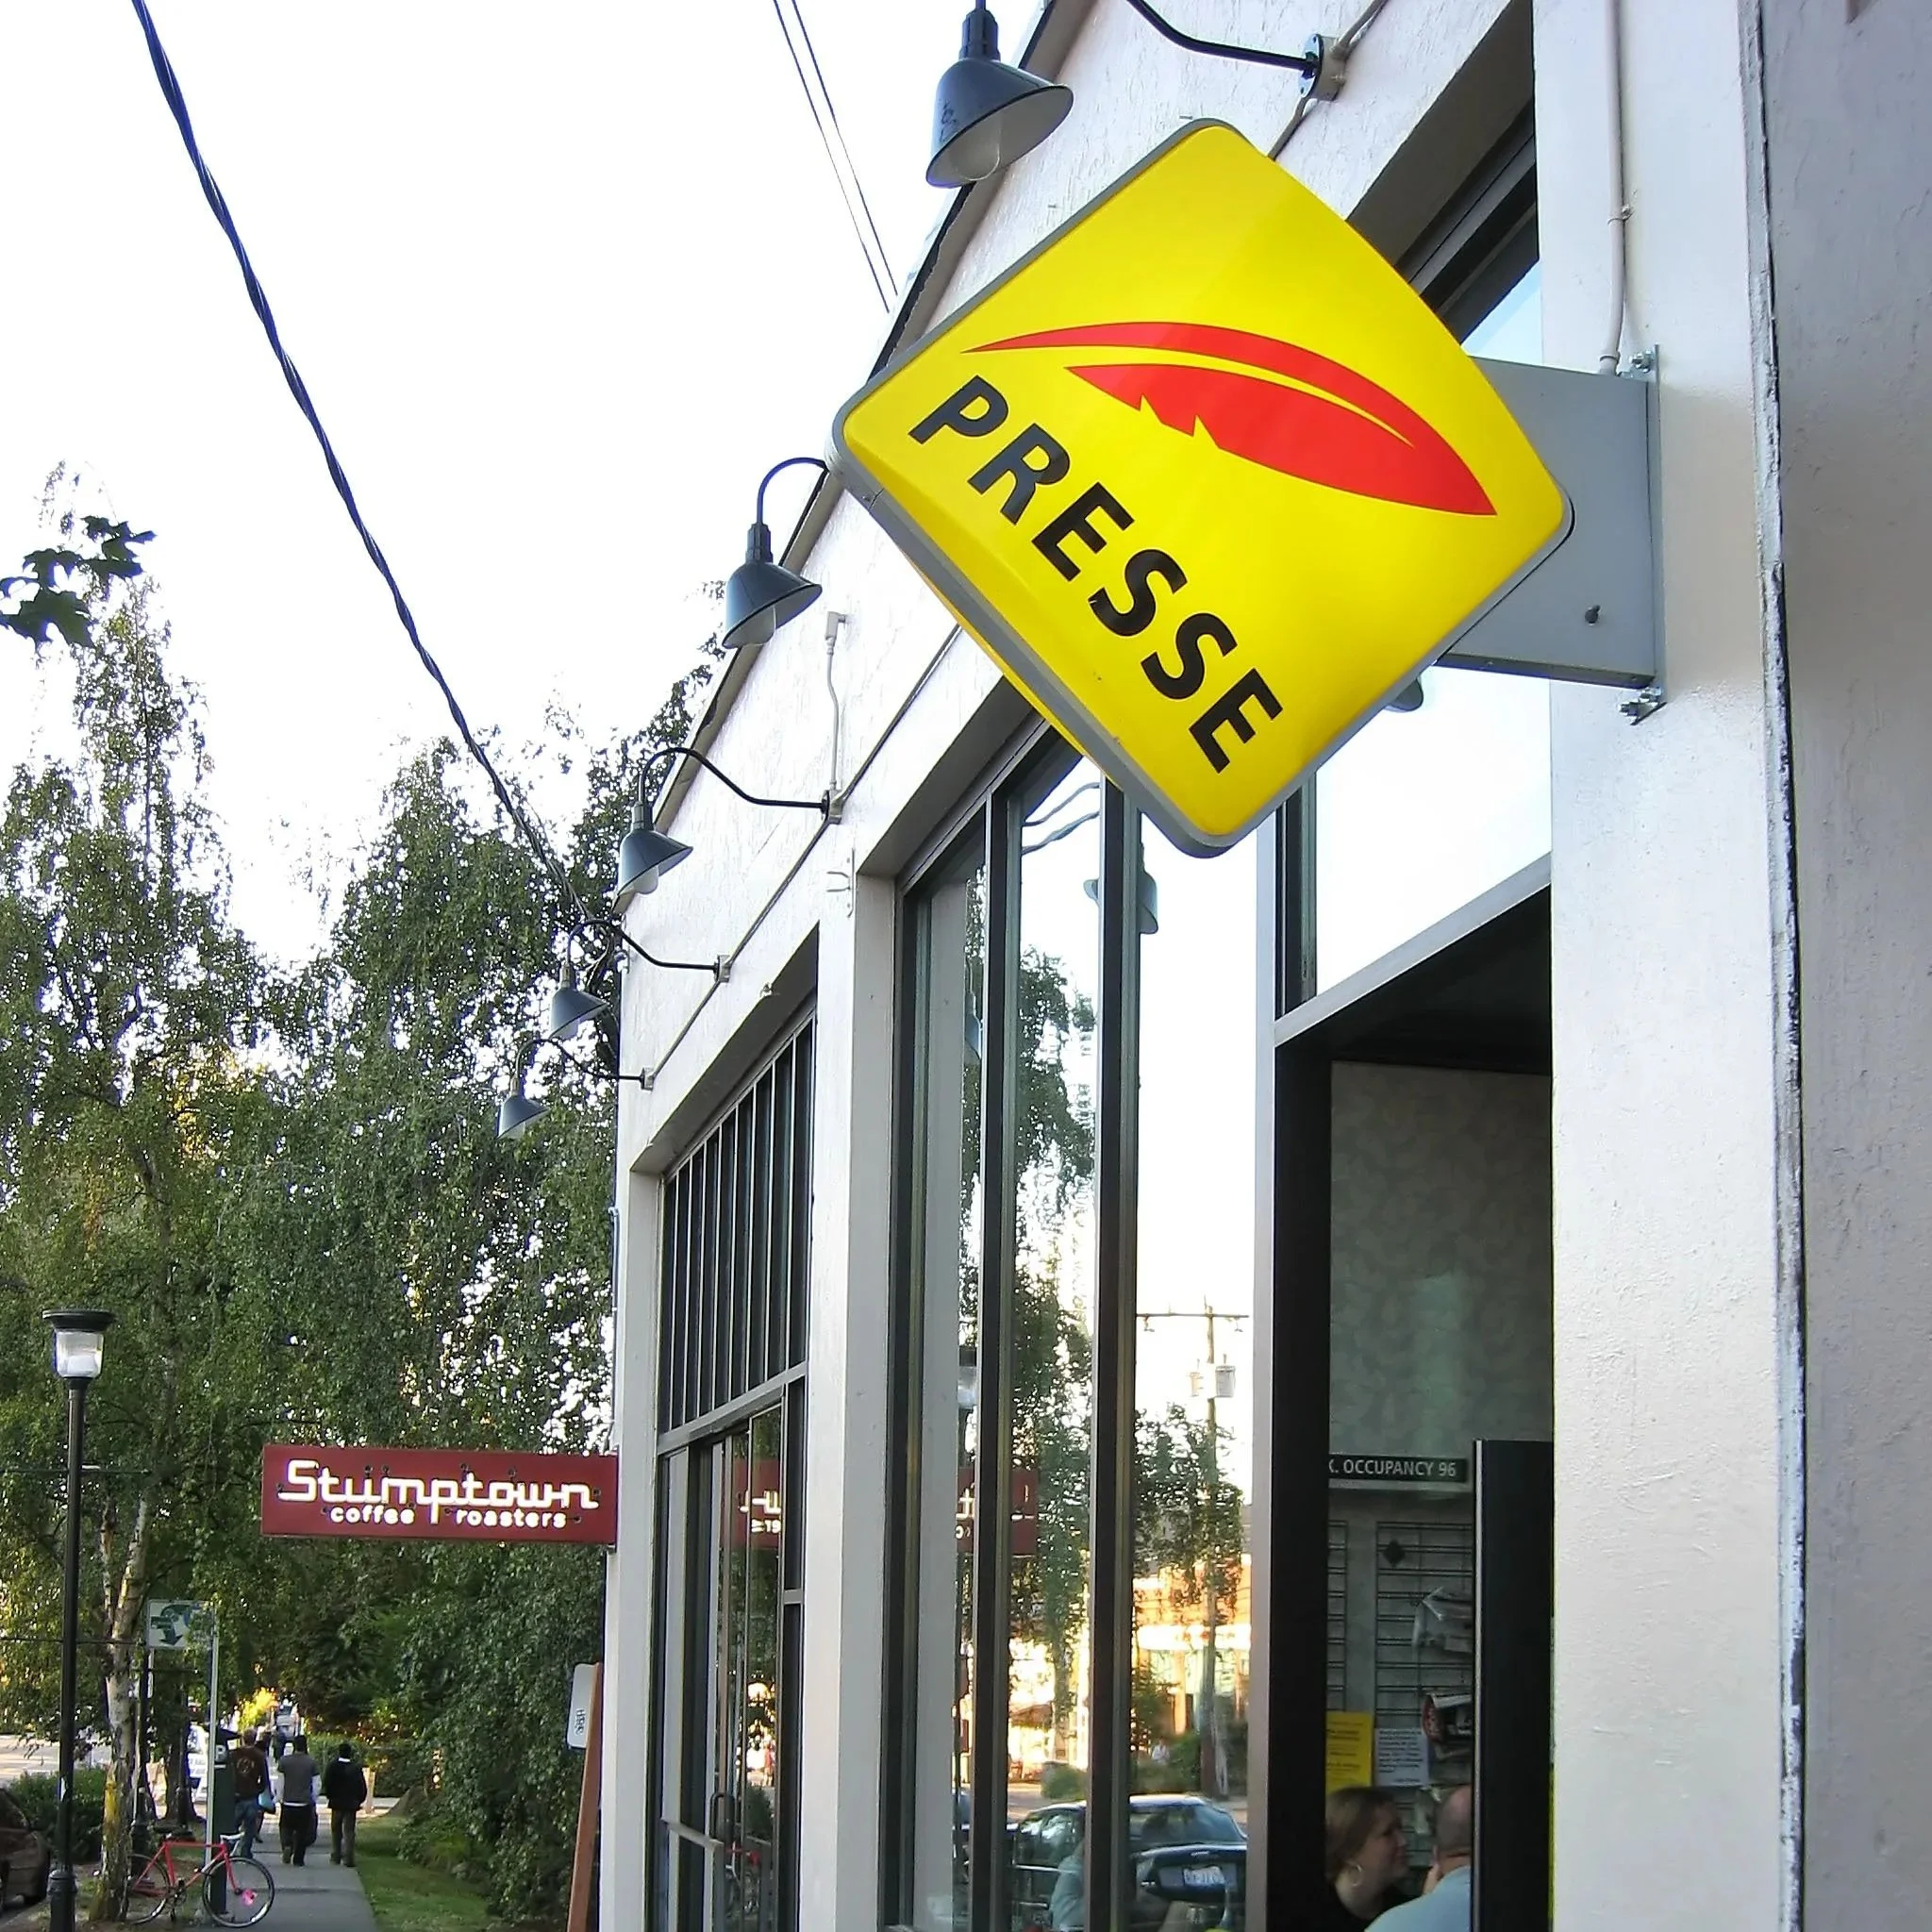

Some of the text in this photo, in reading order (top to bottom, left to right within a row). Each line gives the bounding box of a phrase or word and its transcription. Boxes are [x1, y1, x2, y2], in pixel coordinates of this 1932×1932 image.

[908, 375, 1283, 774] PRESSE
[1342, 1458, 1434, 1476] OCCUPANCY
[1438, 1461, 1457, 1477] 96
[277, 1458, 599, 1524] Stumptown
[330, 1505, 567, 1529] coffee roasters
